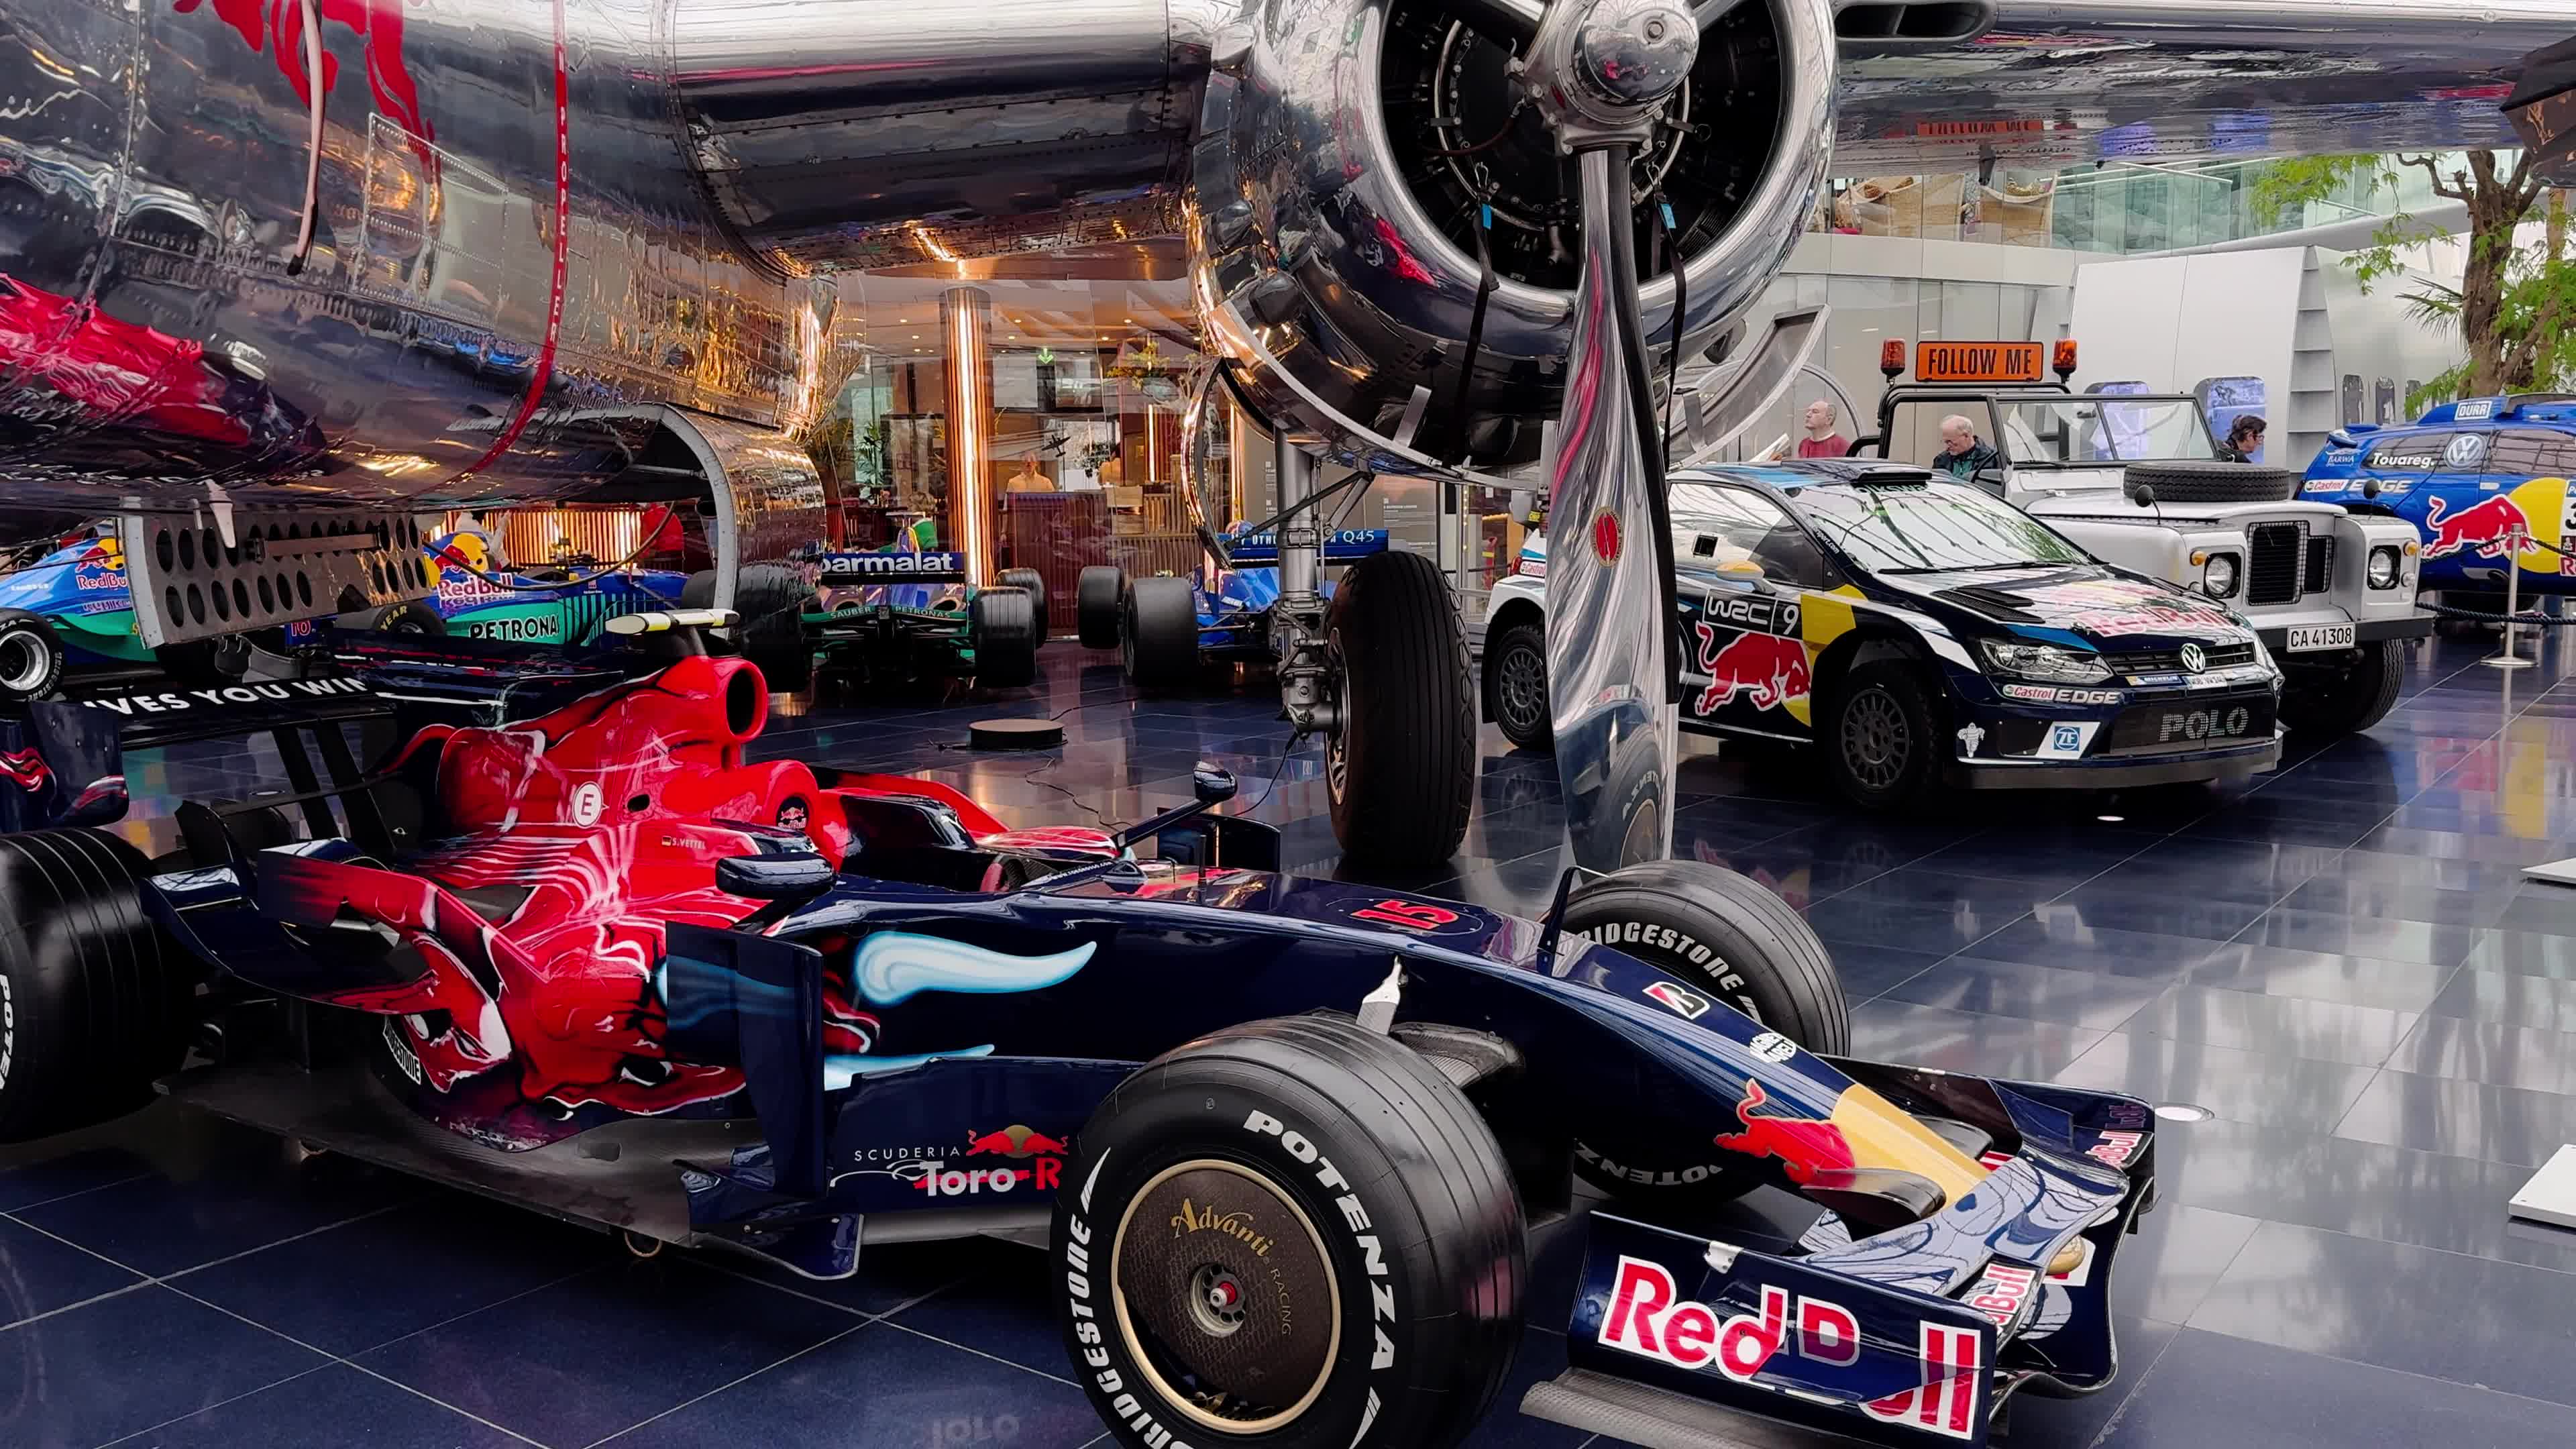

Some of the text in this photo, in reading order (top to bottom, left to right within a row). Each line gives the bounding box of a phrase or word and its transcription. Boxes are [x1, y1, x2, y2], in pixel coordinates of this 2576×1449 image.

[549, 106, 567, 343] PROPELLER
[1928, 348, 2032, 375] FOLLOW ME
[2458, 401, 2488, 417] DÜRR
[2328, 454, 2355, 464] BARWA
[2314, 480, 2413, 493] Castrol EGE
[1342, 529, 1375, 545] Q45
[830, 606, 951, 619] SAUBER PETRONAS
[1707, 596, 1799, 635] WRC 9
[469, 614, 559, 641] PETRONA
[2290, 627, 2352, 648] CA 41308
[190, 684, 291, 706] YOU
[2013, 686, 2122, 704] Castrol EDGE
[2159, 706, 2249, 741] POLO
[2056, 732, 2078, 746] ZF
[581, 794, 594, 816] E
[1350, 899, 1460, 930] 15
[1578, 921, 1745, 991] RIDGESTONE
[854, 1146, 961, 1161] SCUDERIA
[919, 1161, 1016, 1197] Toro
[1170, 1197, 1274, 1256] Advanti
[1243, 1109, 1395, 1371] POTENZA
[1271, 1268, 1292, 1336] RACING
